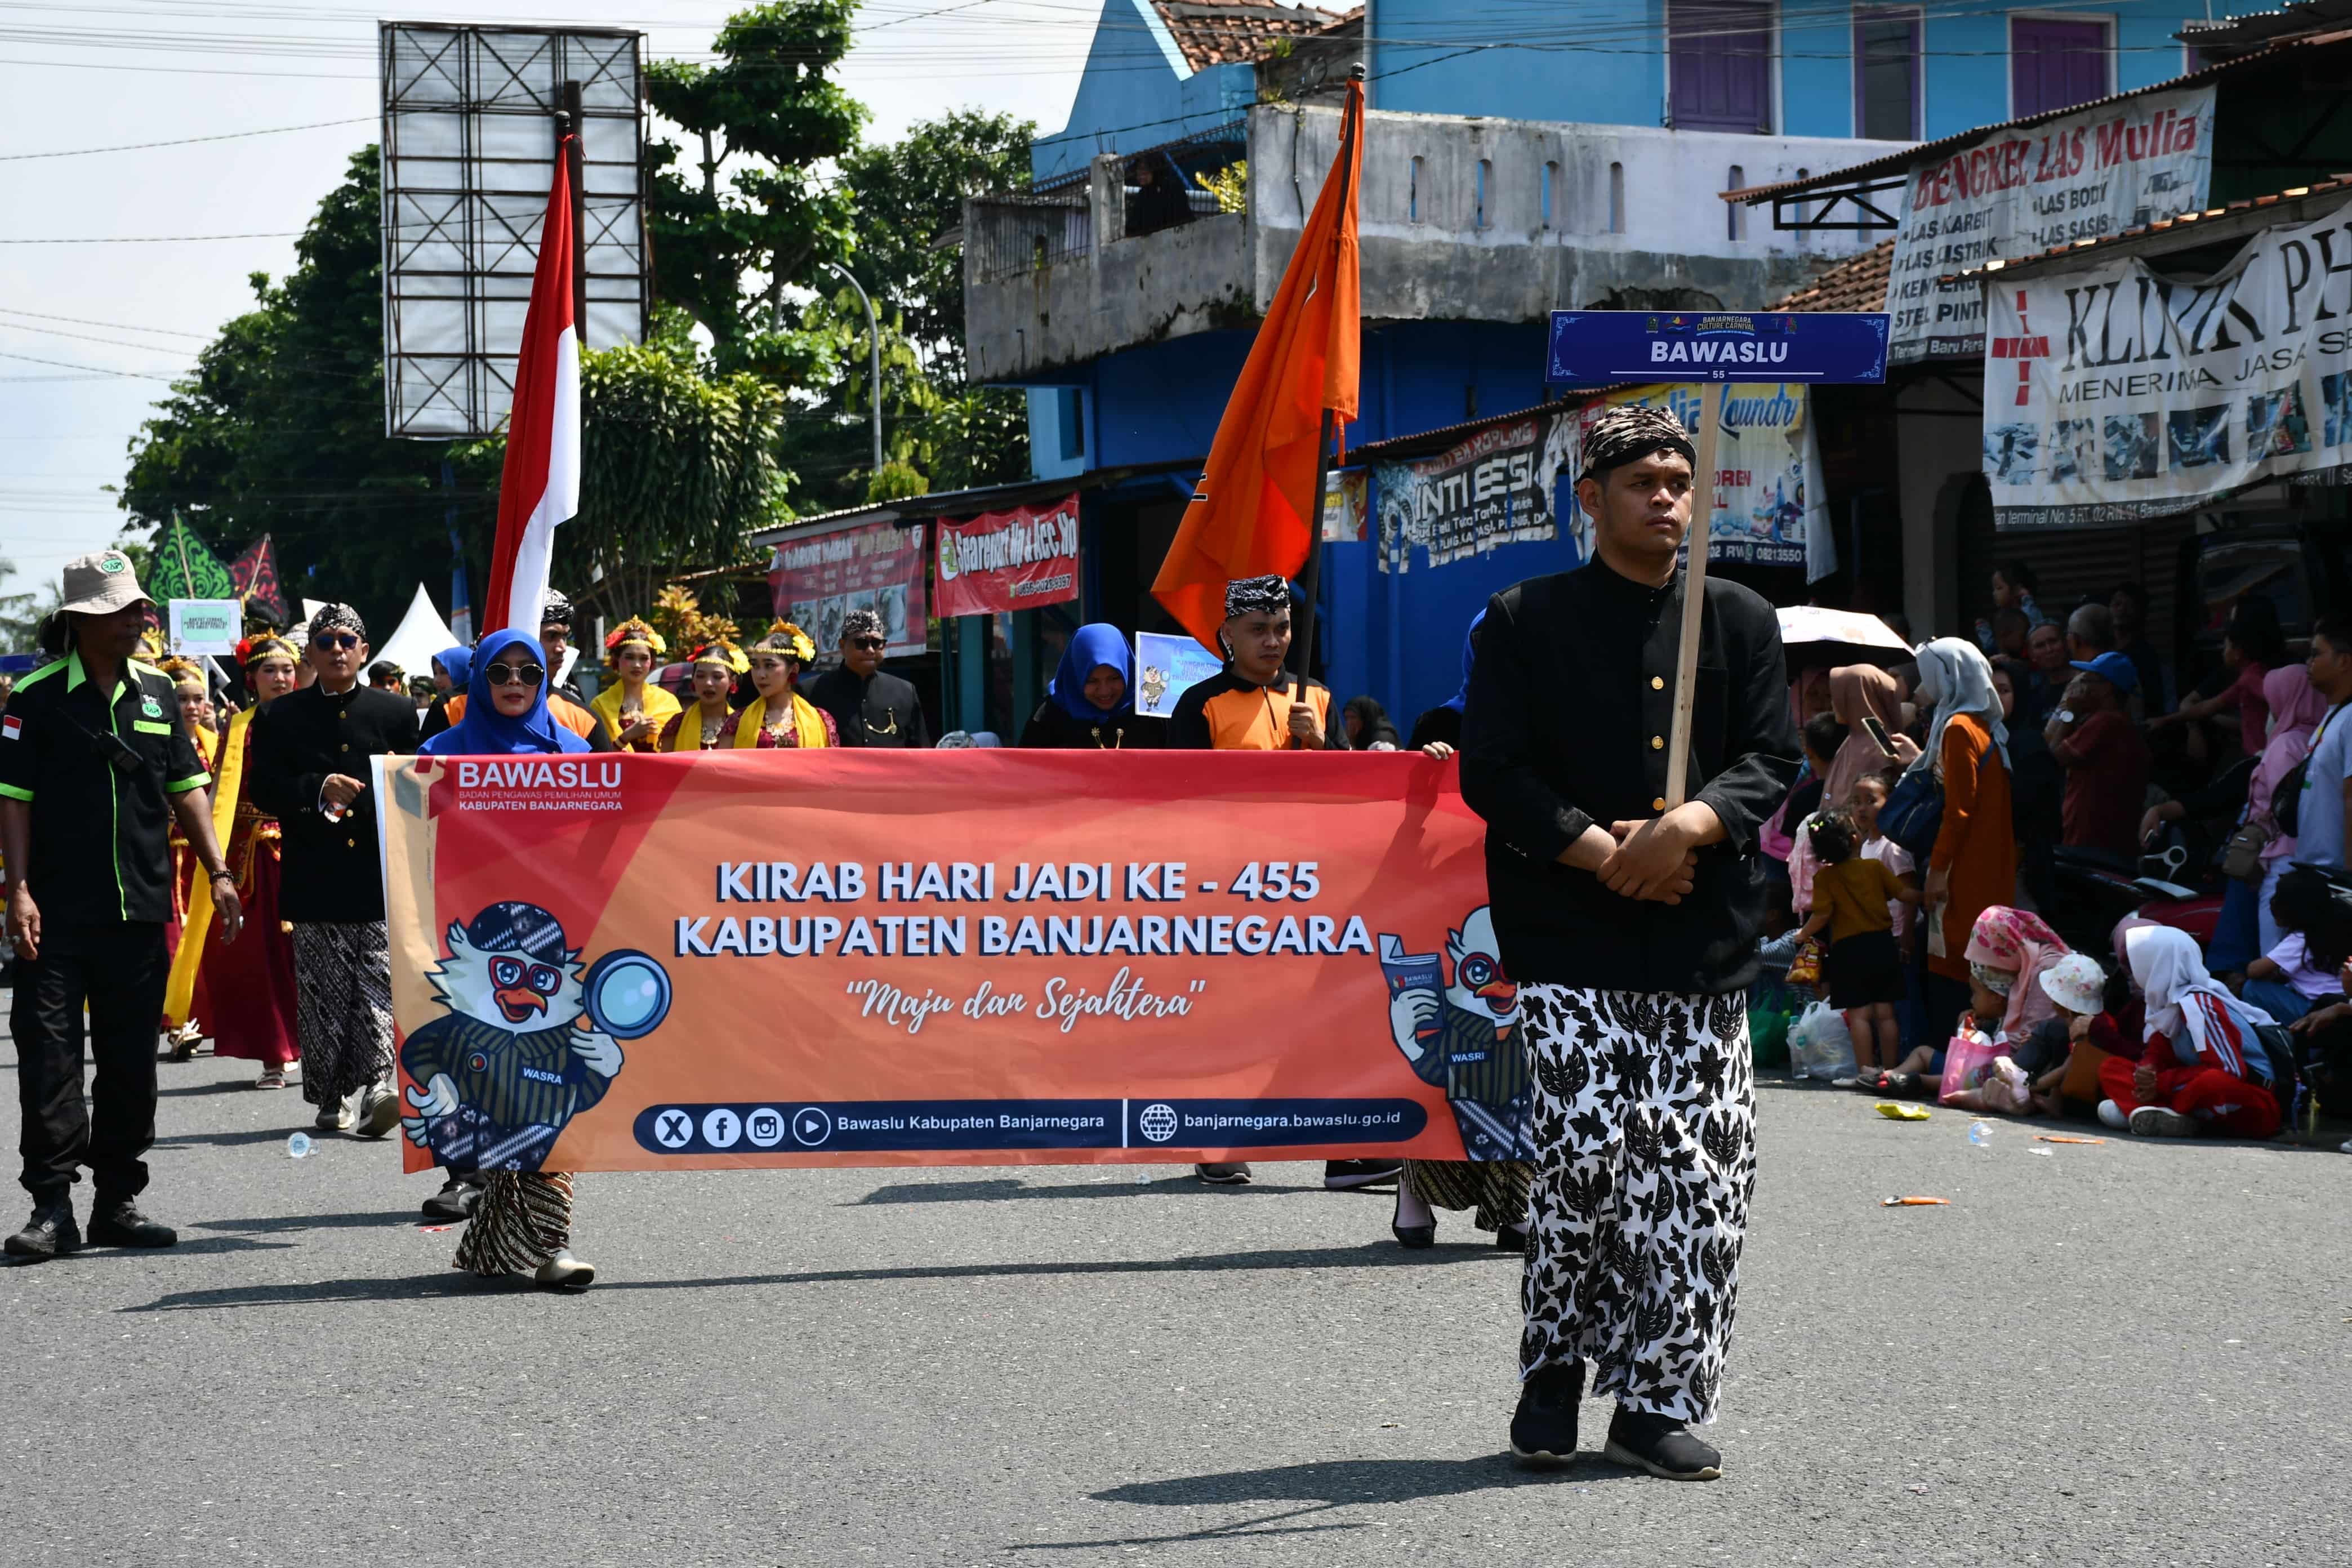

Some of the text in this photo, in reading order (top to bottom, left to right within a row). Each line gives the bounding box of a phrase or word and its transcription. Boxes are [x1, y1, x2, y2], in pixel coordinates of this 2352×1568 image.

[1913, 108, 2198, 210] BENGKEL LAS Mulia
[2039, 181, 2108, 215] LAS BODY
[1910, 207, 1994, 242] LAS KARBIT
[2041, 213, 2108, 246] LAS SASIS
[1905, 249, 1934, 271] LAS
[1697, 322, 1724, 331] CULTURE
[1895, 306, 1930, 328] STEL
[1651, 341, 1788, 363] BAWASLU
[1930, 340, 1960, 354] Baru
[2059, 367, 2224, 404] MENERIMA
[2234, 342, 2306, 381] JASA
[1473, 452, 1534, 503] BESI
[2008, 509, 2048, 524] terminal
[955, 527, 1009, 576] Sparepart
[1034, 516, 1059, 562] Acc
[1056, 511, 1077, 559] Hp
[459, 763, 621, 789] BAWASLU
[459, 801, 623, 810] KABUPATEN BANJARNEGARA
[717, 862, 866, 902] KIRAB
[879, 862, 995, 902] HARI
[1005, 862, 1111, 902] JADI
[1124, 862, 1186, 902] KE
[1228, 861, 1320, 902] 455
[675, 915, 1374, 957] KABUPATEN BANJARNEGARA
[963, 981, 1028, 1019] dan
[1451, 1051, 1485, 1063] WASRI
[523, 1067, 562, 1085] WASRA
[838, 1115, 1104, 1132] Bawaslu Kabupaten Banjarnegara
[1185, 1111, 1401, 1130] banjarnegara.bawaslu.go.id
